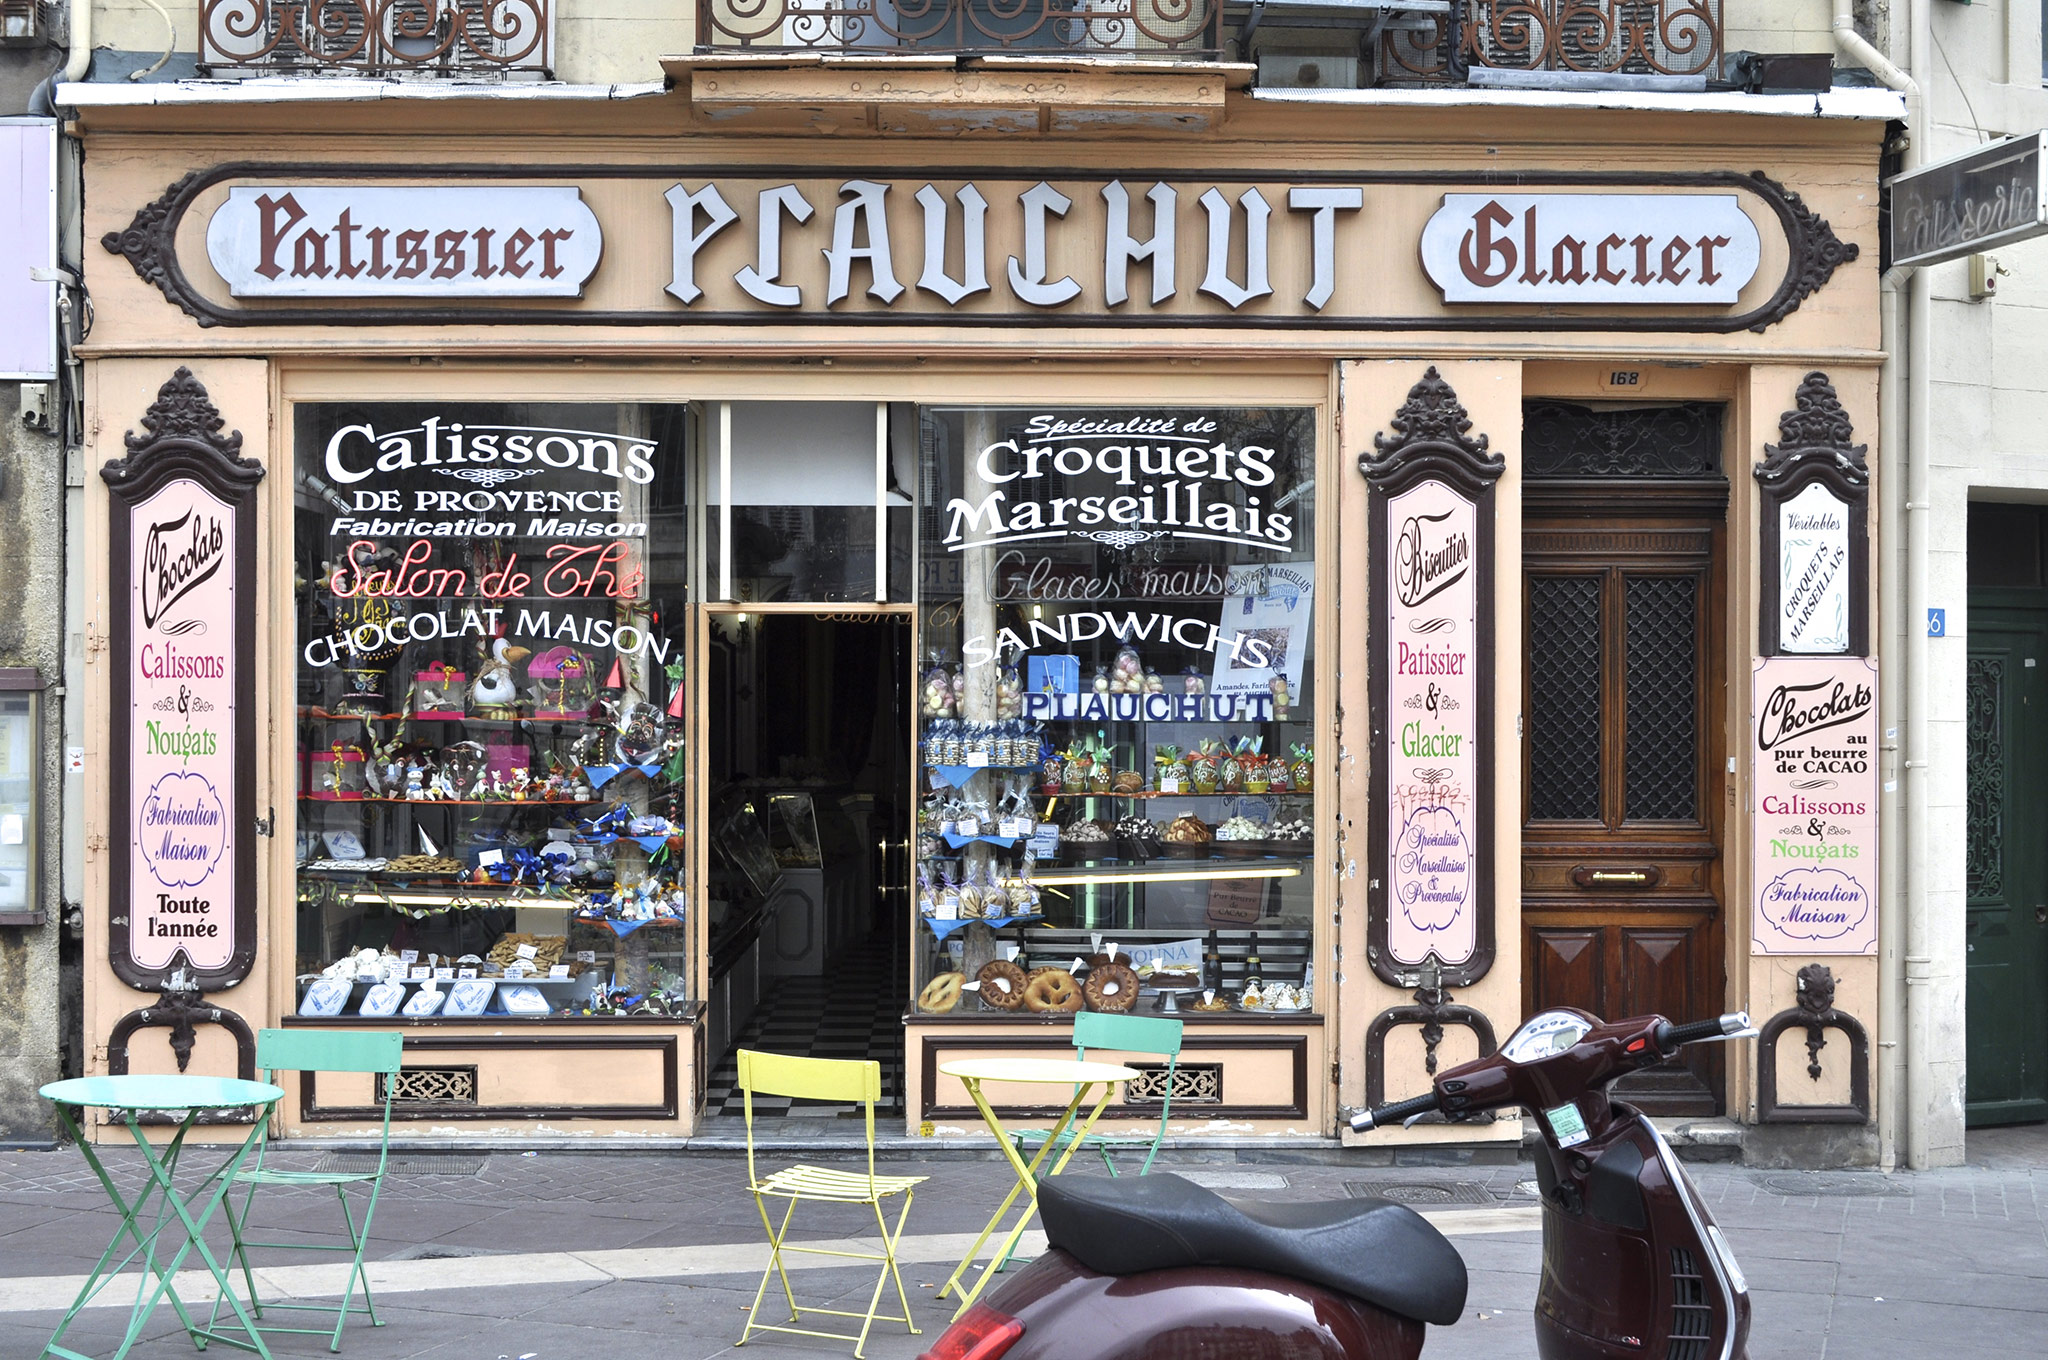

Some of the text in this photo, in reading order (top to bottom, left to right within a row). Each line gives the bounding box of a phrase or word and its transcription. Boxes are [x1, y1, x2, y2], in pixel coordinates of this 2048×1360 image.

[253, 192, 574, 280] Patissier
[663, 180, 1363, 311] PLAUCHUT
[1459, 199, 1731, 287] Glacier
[1610, 371, 1639, 386] 168
[1024, 415, 1217, 435] Spécialité de
[325, 416, 656, 485] Calissons
[976, 438, 1275, 486] Croquets
[353, 490, 625, 513] DE PROVENCE
[942, 480, 1293, 544] Marseillais
[330, 518, 648, 536] Fabrication Maison
[1787, 512, 1841, 531] Véritables
[143, 504, 224, 629] Chocolats
[331, 540, 644, 600] Salon de Thé
[1395, 507, 1469, 607] Biscuitier
[987, 550, 1120, 600] Glaces
[1268, 567, 1312, 594] MARSEILLAIS
[1784, 541, 1829, 619] CROQUETS
[1790, 546, 1845, 643] MARSEILLAIS
[304, 608, 504, 667] CHOCOLAT
[515, 610, 671, 664] MAISON
[962, 611, 1273, 668] SANDWICHS
[141, 641, 224, 679] Calissons
[1398, 642, 1466, 675] Patissier
[177, 684, 191, 721] &
[1022, 693, 1274, 721] PLAUCHUT
[1425, 682, 1441, 719] &
[1758, 675, 1872, 751] Chocolats
[146, 720, 217, 765] Nougats
[1402, 719, 1462, 758] Glacier
[1774, 747, 1867, 761] pur beurre
[1847, 736, 1867, 744] au
[1776, 761, 1867, 774] de CACAO
[147, 795, 220, 827] Fabrication
[1763, 794, 1865, 815] Calissons
[155, 830, 210, 861] Maison
[1406, 824, 1459, 853] Spécialités
[1807, 818, 1826, 841] &
[1400, 851, 1465, 875] Marseillaises
[1770, 839, 1859, 863] Nougats
[157, 894, 210, 914] Toute
[1770, 882, 1861, 902] Fabrication
[148, 917, 218, 938] l'année
[1781, 904, 1850, 924] Maison
